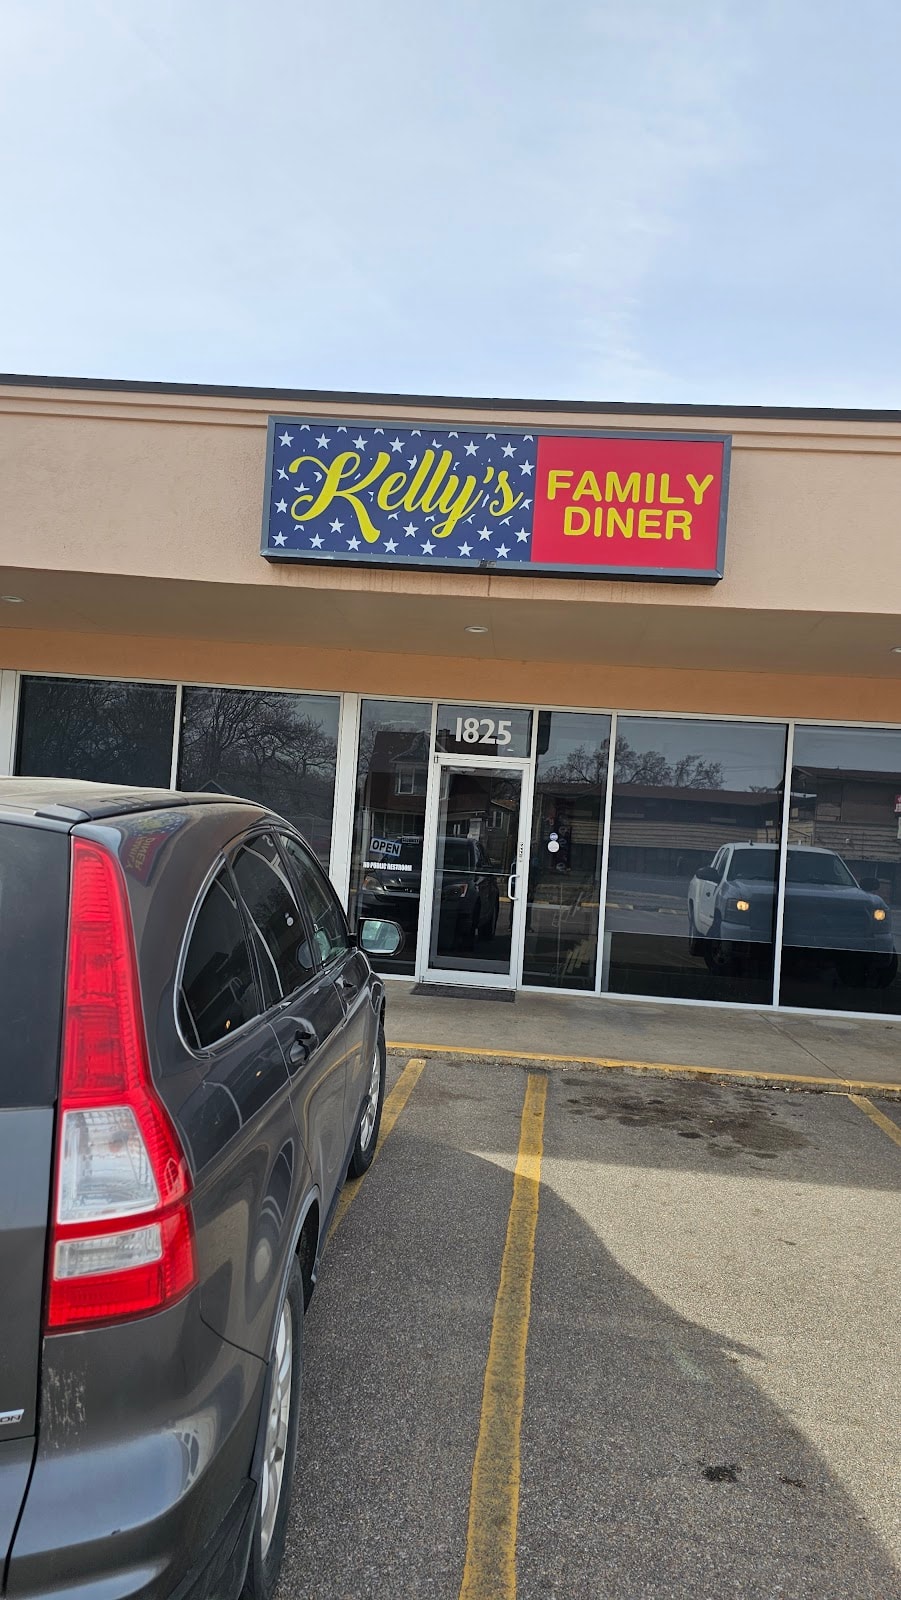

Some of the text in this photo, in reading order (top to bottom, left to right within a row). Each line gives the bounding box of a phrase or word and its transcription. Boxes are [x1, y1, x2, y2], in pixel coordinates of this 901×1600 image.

[288, 449, 524, 544] Kelly's
[547, 470, 714, 505] FAMILY
[564, 506, 693, 541] DINER
[455, 717, 512, 746] 1825
[372, 840, 400, 855] OPEN
[370, 862, 387, 870] PUBLIC
[387, 863, 413, 872] RESTROOM
